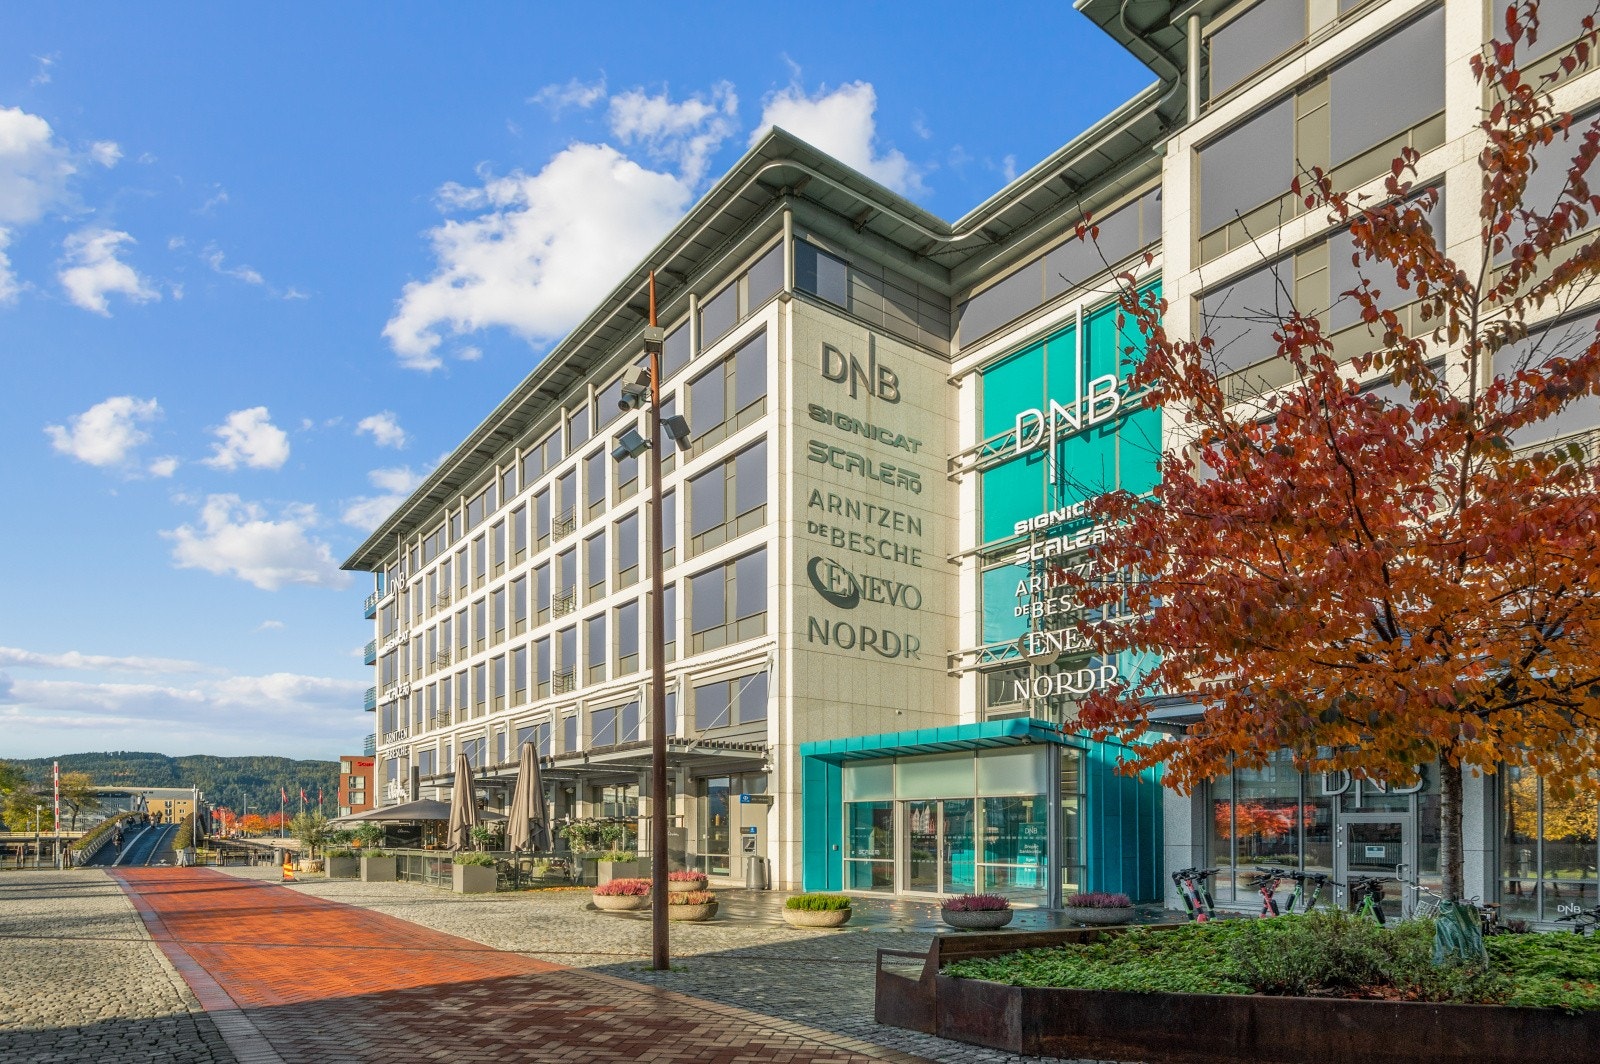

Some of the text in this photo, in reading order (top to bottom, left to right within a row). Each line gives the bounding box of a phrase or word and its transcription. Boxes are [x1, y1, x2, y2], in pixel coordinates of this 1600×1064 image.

[821, 332, 900, 403] DNB
[1015, 303, 1120, 485] DNB
[808, 403, 922, 453] SIGNICAT
[808, 488, 922, 537] ARNTZEN
[831, 526, 922, 567] BESCHE
[823, 562, 922, 610] ENEVO
[808, 615, 921, 661] NORDR
[1014, 665, 1119, 701] NORDR
[1557, 902, 1581, 915] DNB
